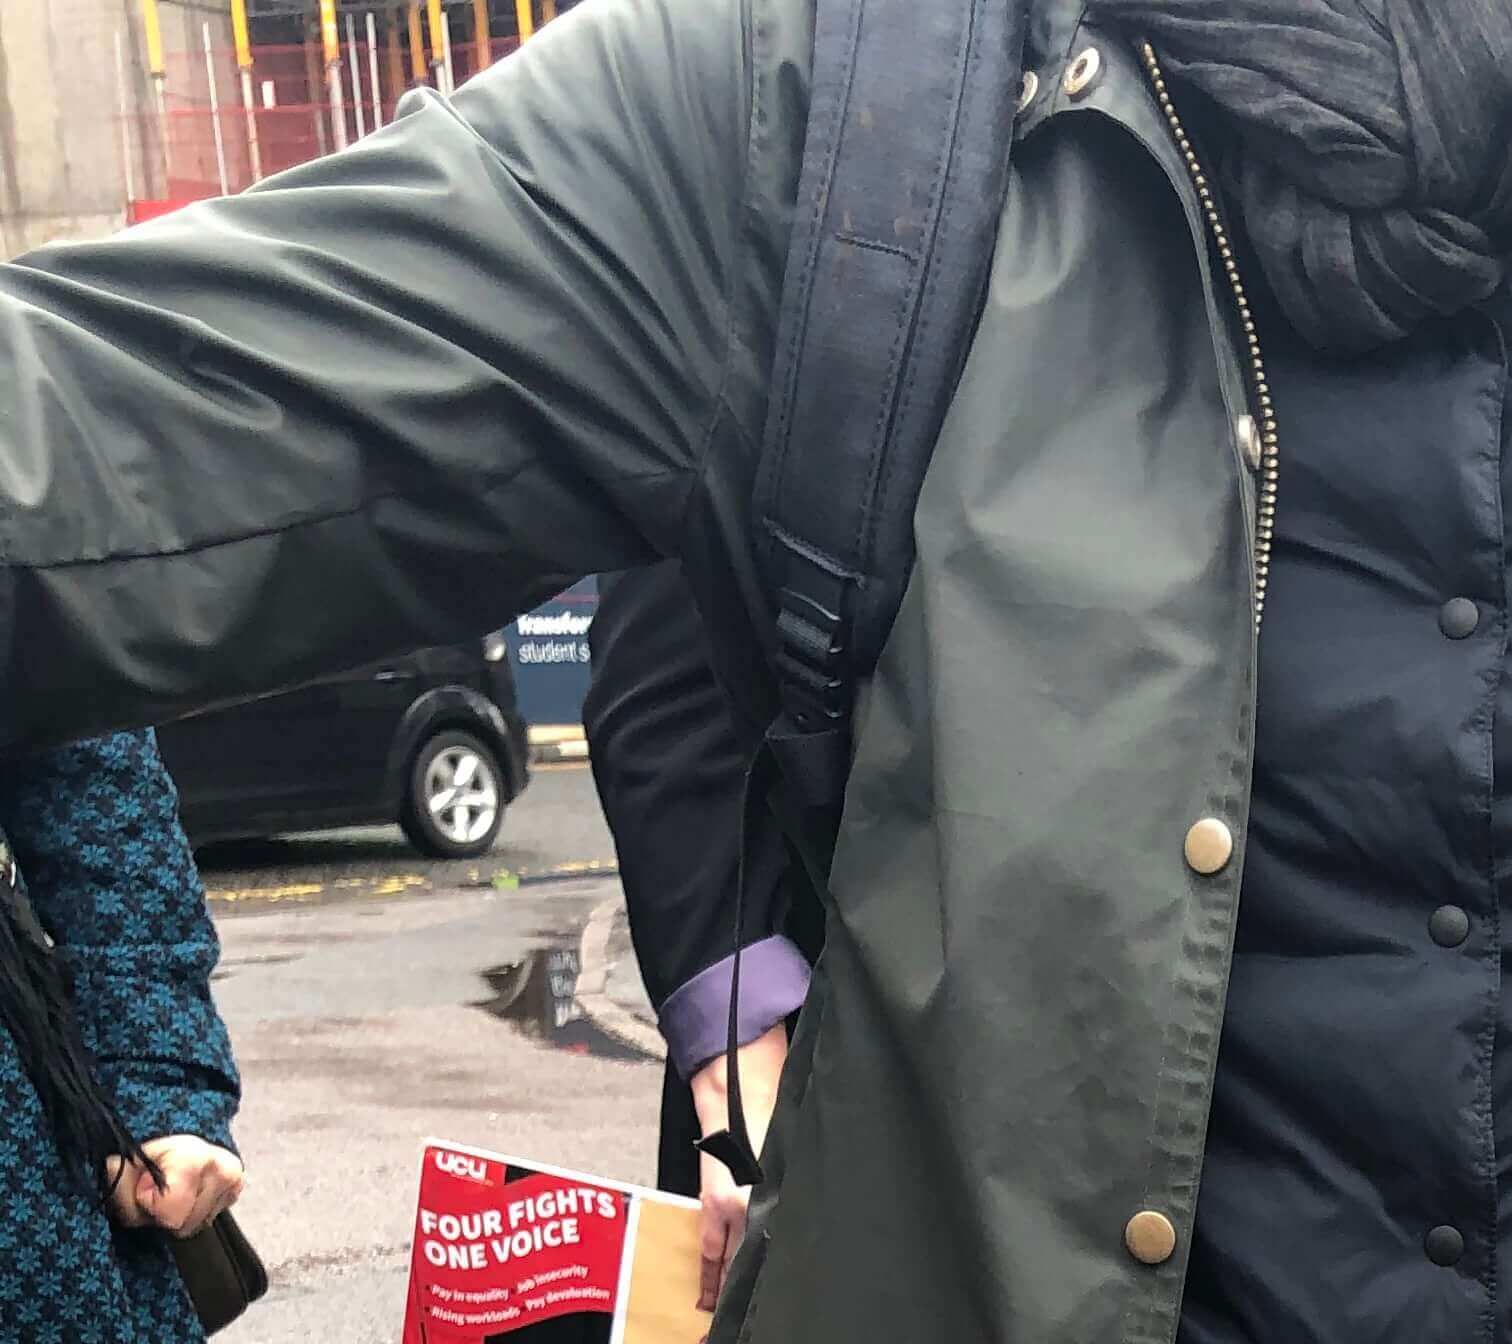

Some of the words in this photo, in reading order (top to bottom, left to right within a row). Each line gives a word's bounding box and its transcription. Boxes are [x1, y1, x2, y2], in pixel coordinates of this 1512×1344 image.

[518, 640, 577, 664] student
[420, 1208, 503, 1241] FOUR
[508, 1188, 617, 1229] FIGHTS
[423, 1239, 488, 1270] ONE
[491, 1218, 580, 1263] VOICE
[432, 1284, 452, 1304] Pay
[432, 1306, 465, 1326] Rising
[465, 1307, 520, 1324] workloads
